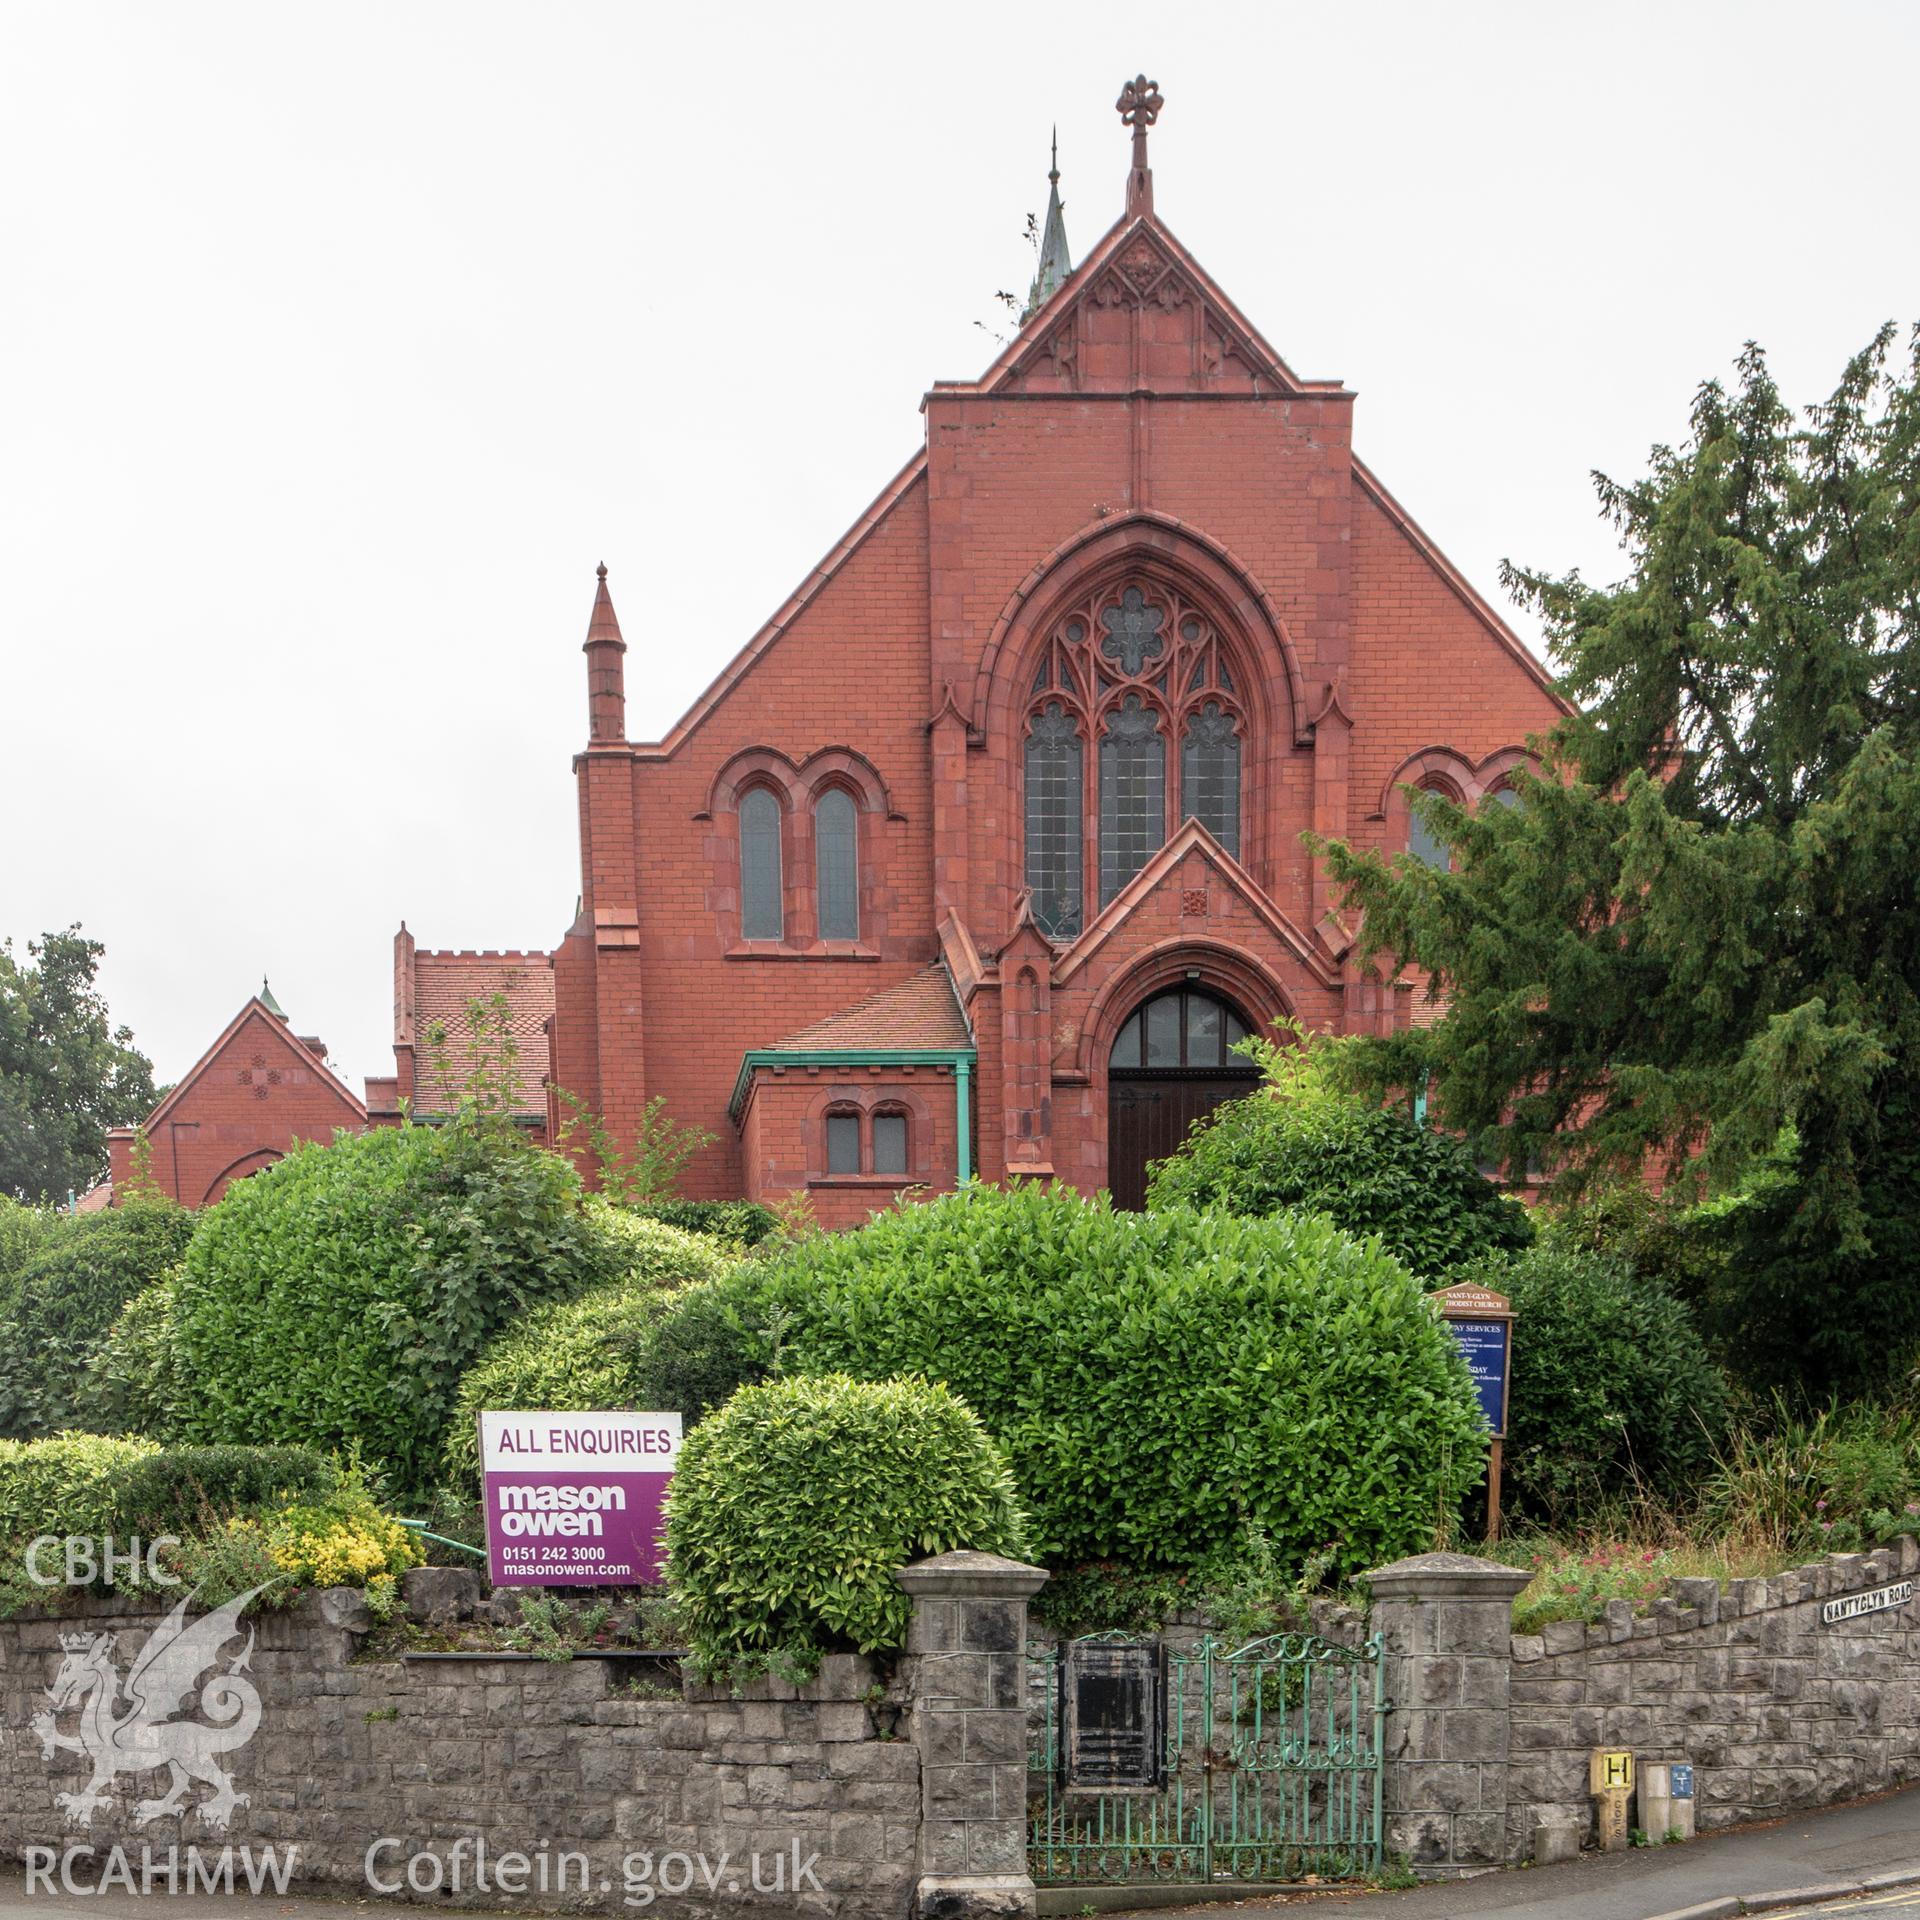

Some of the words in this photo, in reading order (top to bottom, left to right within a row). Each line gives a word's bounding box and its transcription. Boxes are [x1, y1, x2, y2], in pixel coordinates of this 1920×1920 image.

[1473, 1301, 1502, 1309] CHURCH
[1465, 1325, 1501, 1333] SERVICES
[499, 1429, 543, 1453] ALL
[549, 1429, 671, 1455] ENQUIRIES
[498, 1485, 626, 1510] mason
[500, 1511, 603, 1537] owen
[503, 1547, 537, 1560] 0151
[542, 1547, 567, 1560] 242
[571, 1547, 605, 1560] 3000
[503, 1564, 631, 1576] masonowen.com
[1826, 1590, 1886, 1621] NANTYGLYN
[1888, 1583, 1913, 1603] ROAD
[1608, 1757, 1627, 1785] H
